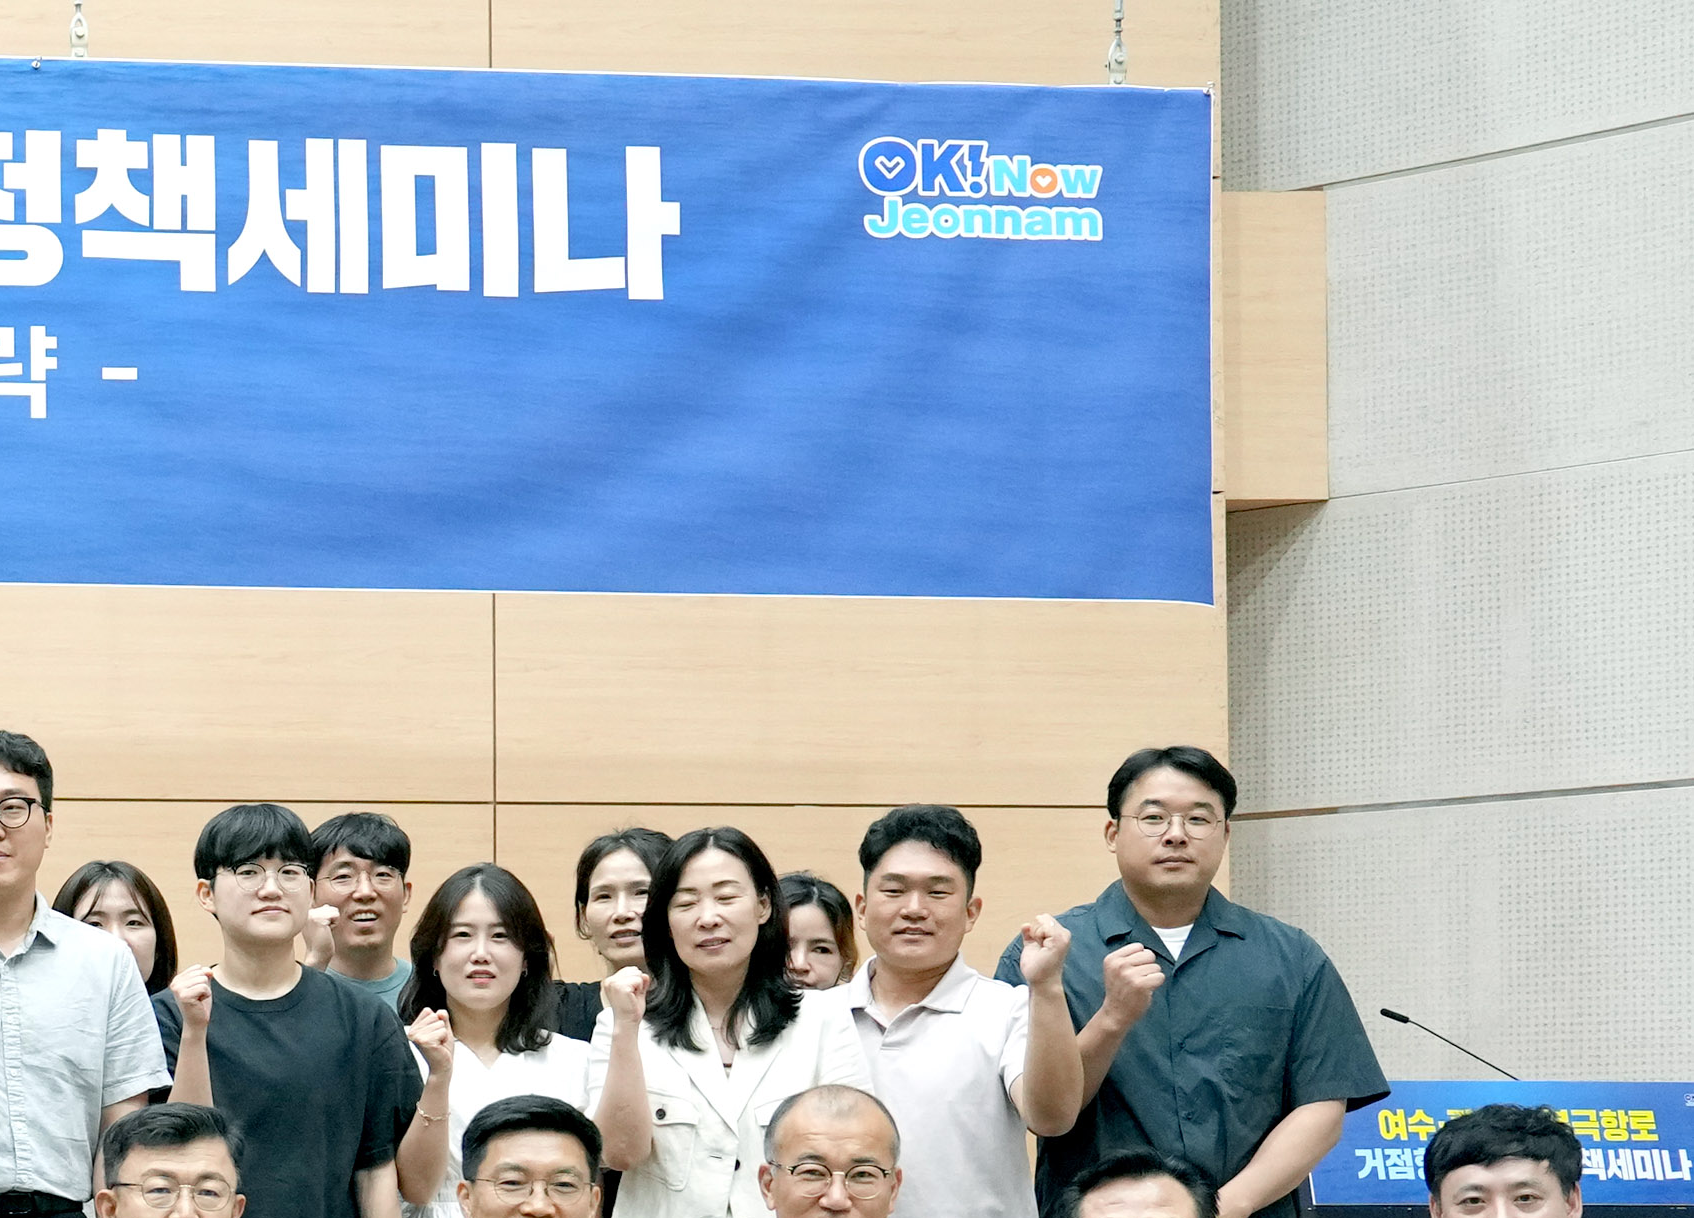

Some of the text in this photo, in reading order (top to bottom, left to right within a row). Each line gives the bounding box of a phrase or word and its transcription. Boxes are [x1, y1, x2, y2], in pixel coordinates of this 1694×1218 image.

[860, 137, 1102, 198] OK! Now
[864, 197, 1103, 241] Jeonnam
[1582, 1148, 1693, 1180] 책세미나
